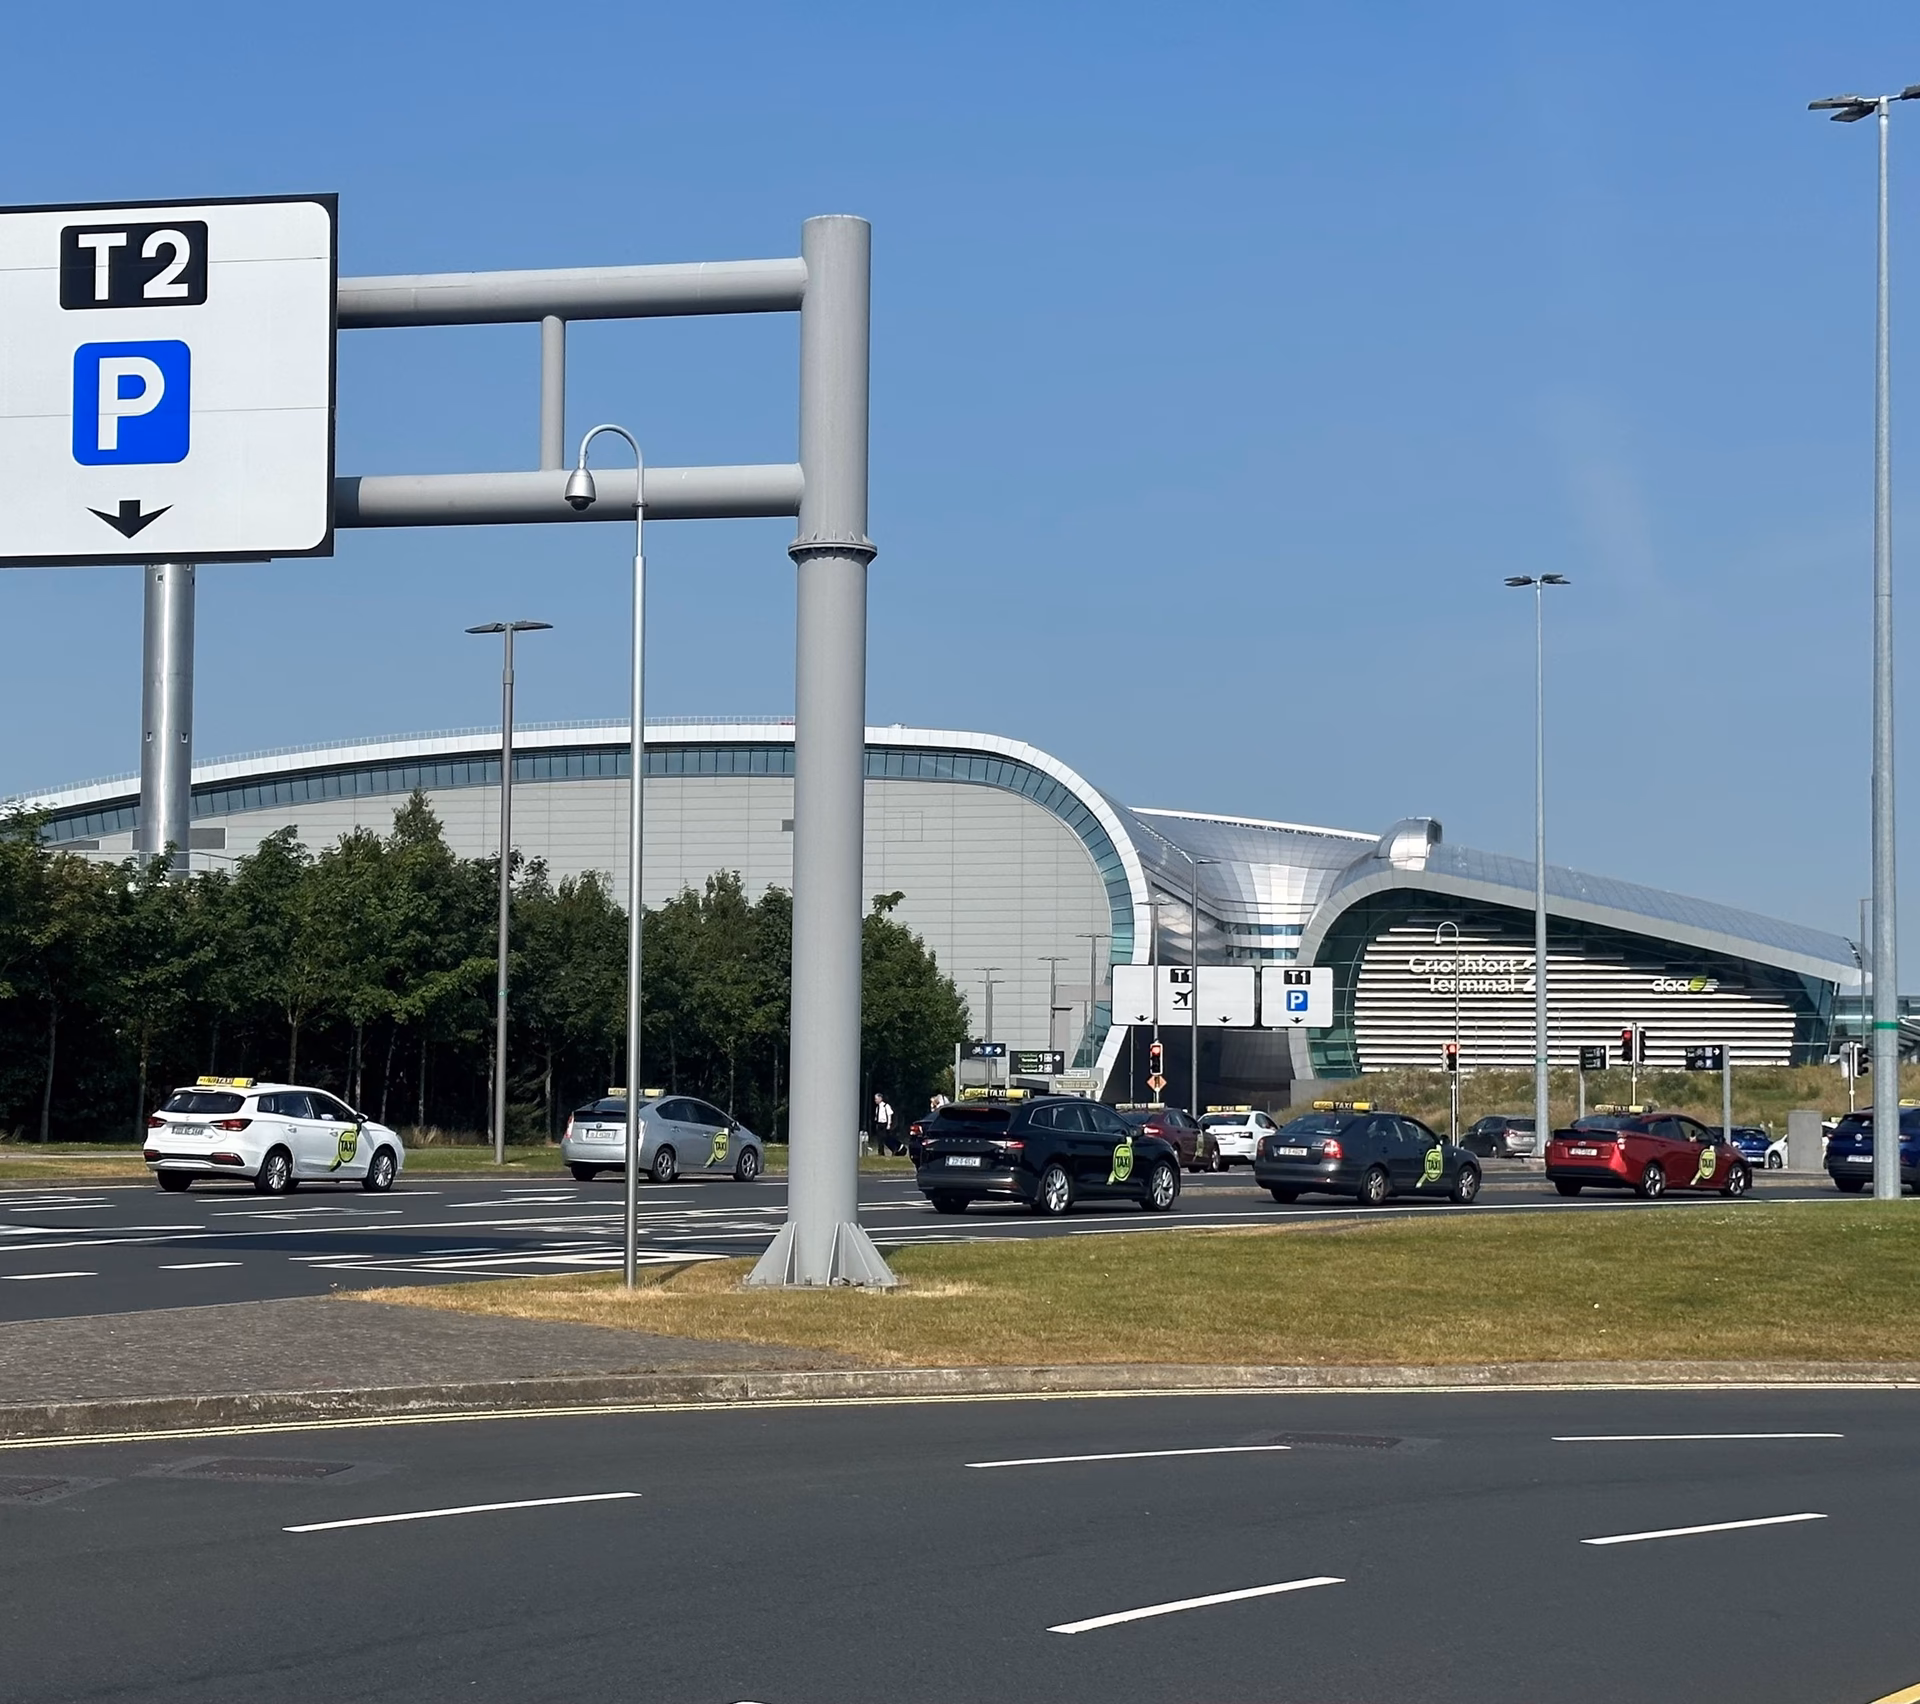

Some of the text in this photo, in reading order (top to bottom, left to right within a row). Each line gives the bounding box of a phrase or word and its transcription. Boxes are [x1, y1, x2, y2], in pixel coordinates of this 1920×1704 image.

[77, 229, 191, 301] T2
[98, 356, 166, 451] P
[1174, 970, 1192, 982] T1
[1288, 971, 1306, 984] T1
[1430, 974, 1515, 992] Terminal
[1653, 975, 1690, 992] daa
[1290, 992, 1304, 1010] P
[990, 1088, 1006, 1097] TAXI
[1334, 1101, 1352, 1109] TAXI
[340, 1140, 355, 1152] TAXI
[1115, 1156, 1130, 1168] TAXI
